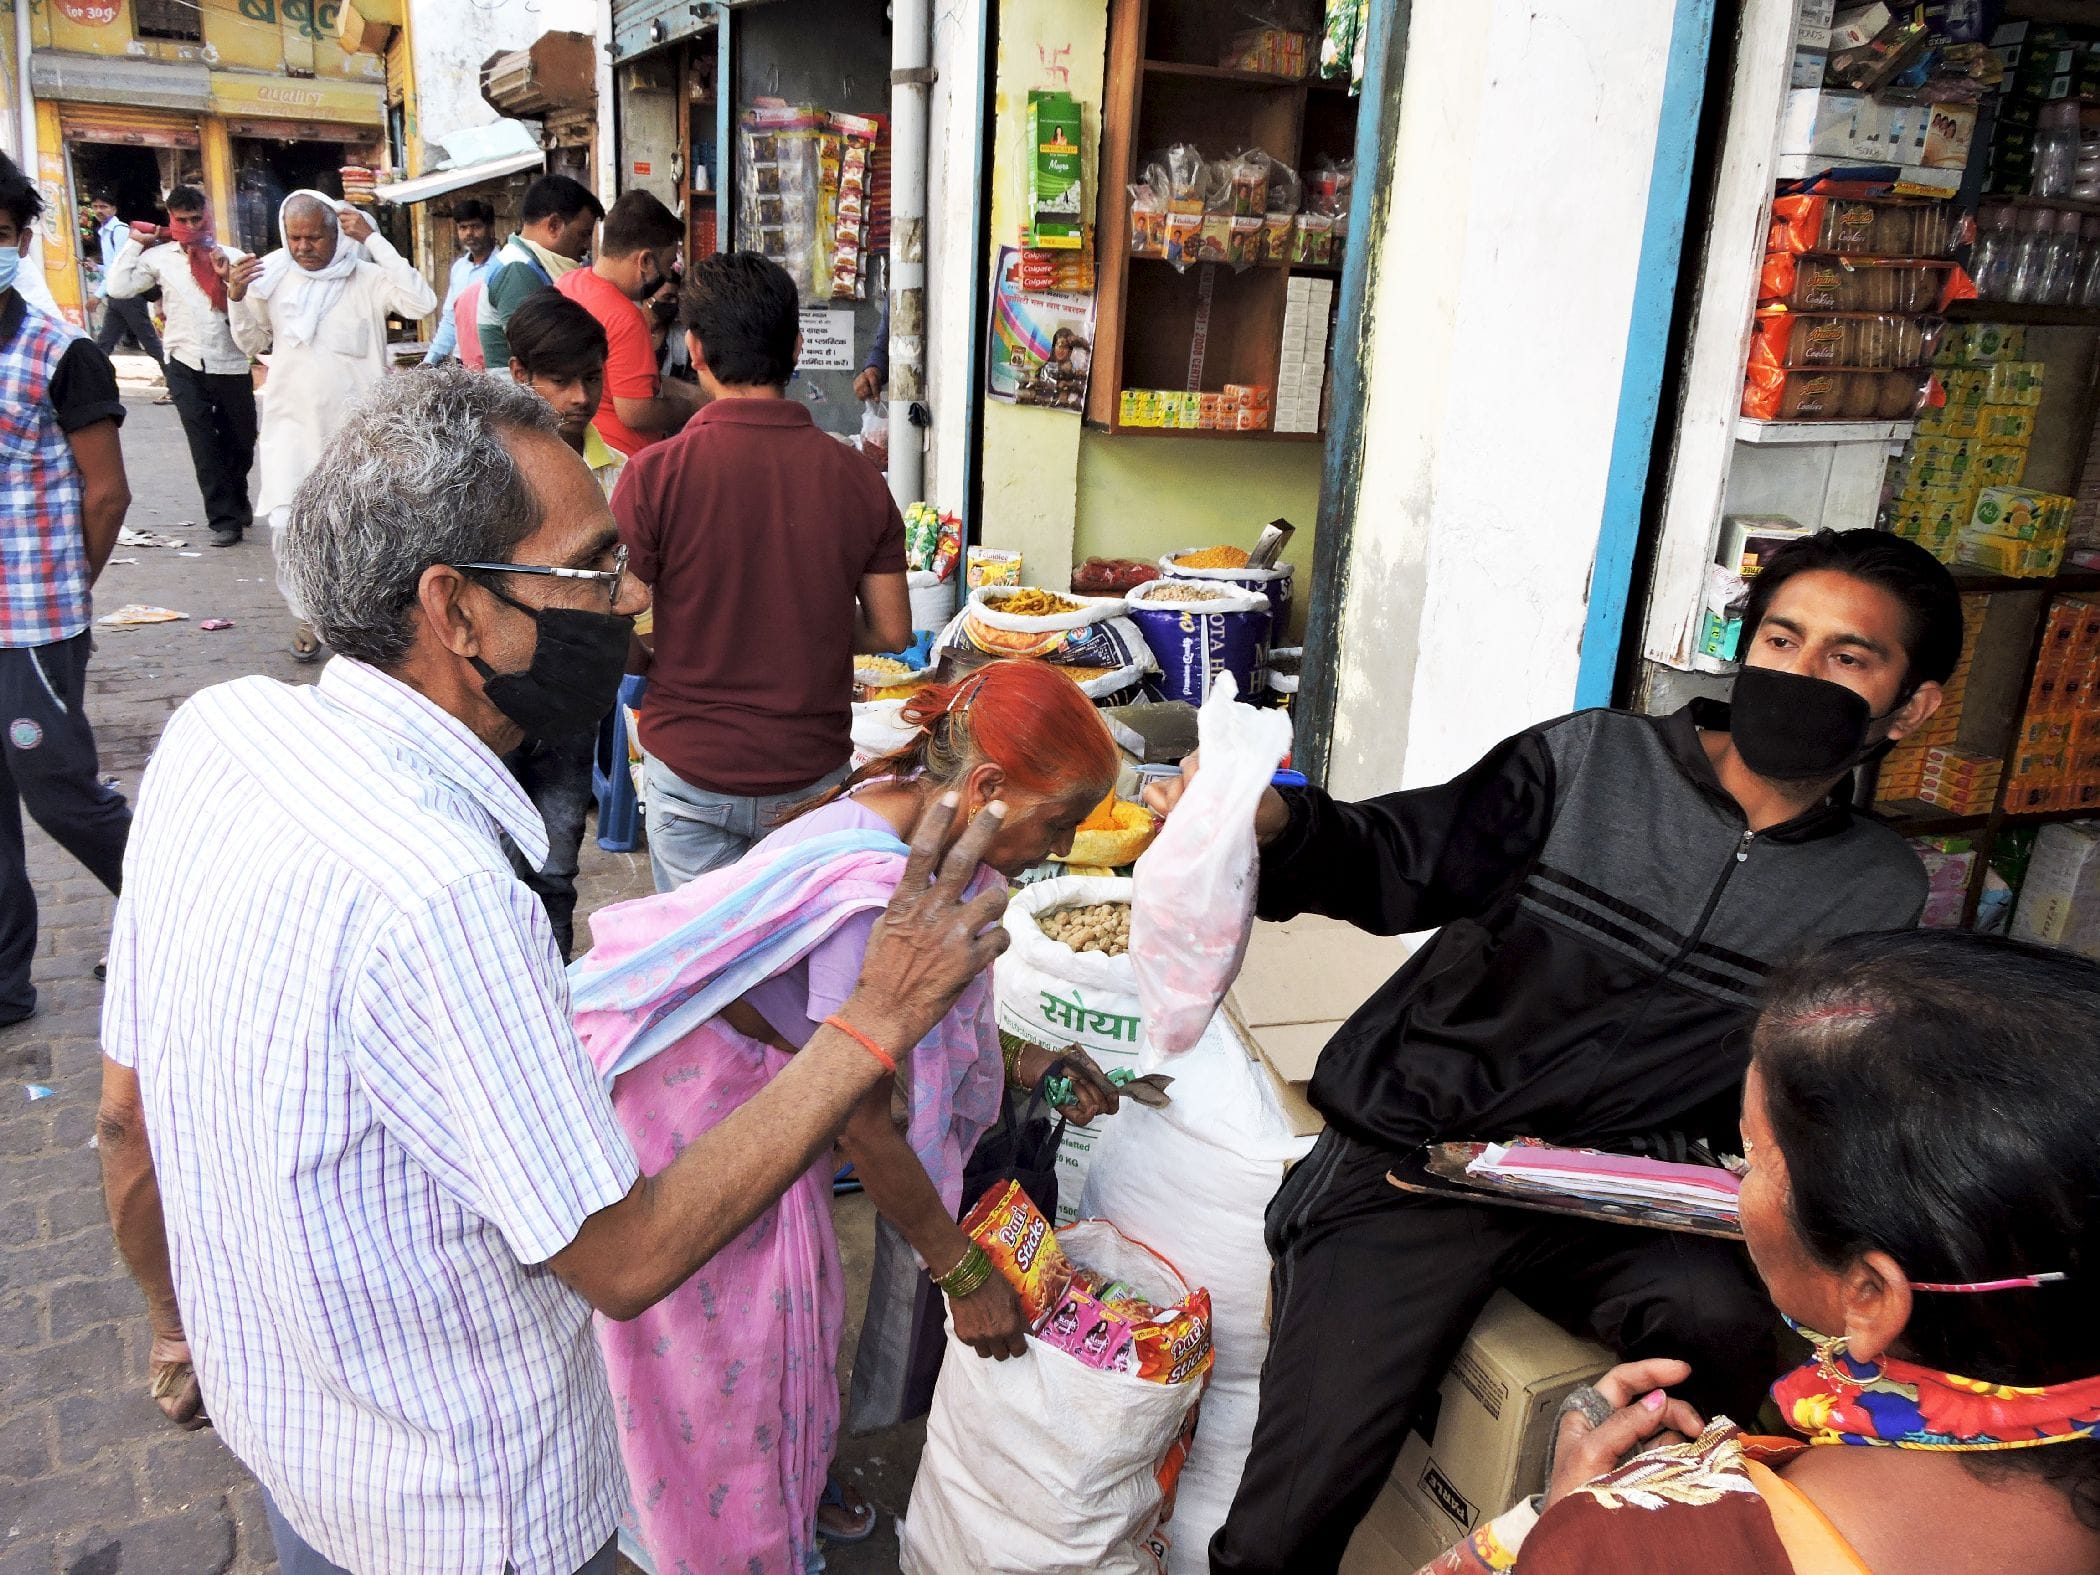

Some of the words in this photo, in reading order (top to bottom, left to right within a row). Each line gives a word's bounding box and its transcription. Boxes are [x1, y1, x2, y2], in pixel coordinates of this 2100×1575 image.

[1023, 264, 1053, 274] Colgate
[1024, 278, 1053, 287] Colgate
[1192, 333, 1206, 356] 2008
[1039, 989, 1141, 1042] सोया
[1065, 1156, 1079, 1167] KG
[999, 1205, 1027, 1247] Pari
[1016, 1217, 1044, 1271] Sticks
[1171, 1316, 1205, 1361] Pari
[1167, 1342, 1210, 1385] Sticks
[1426, 1472, 1466, 1522] PARLE
